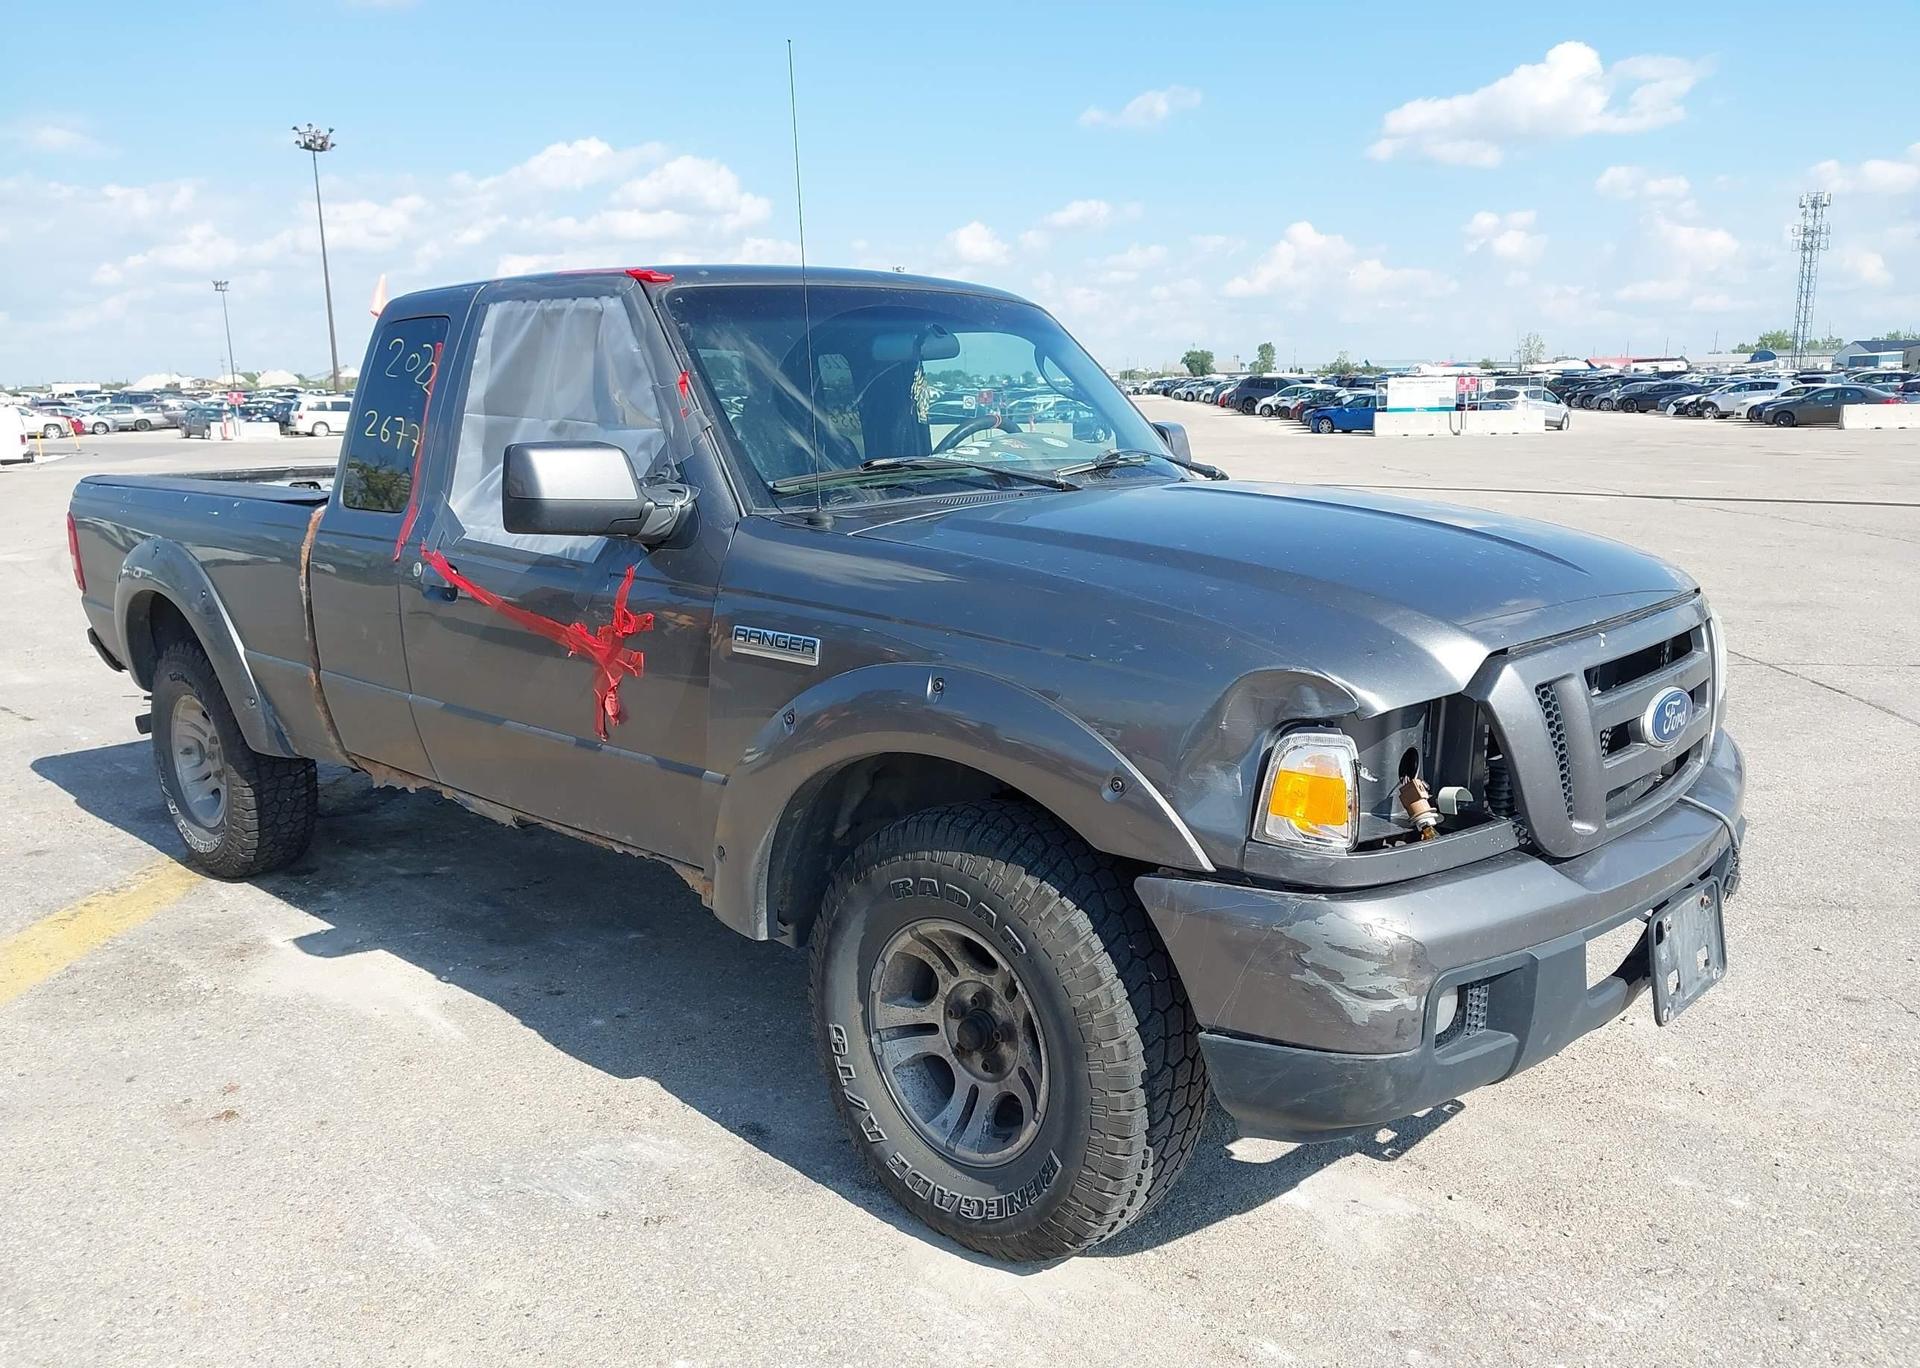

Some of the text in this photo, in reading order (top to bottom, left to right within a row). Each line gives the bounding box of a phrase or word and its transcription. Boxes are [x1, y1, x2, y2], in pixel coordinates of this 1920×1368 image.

[364, 410, 420, 457] 2677
[734, 627, 817, 654] RANGER
[1663, 698, 1688, 735] Ford
[889, 877, 1027, 957] RADAR
[885, 1149, 1064, 1220] RENEGADE
